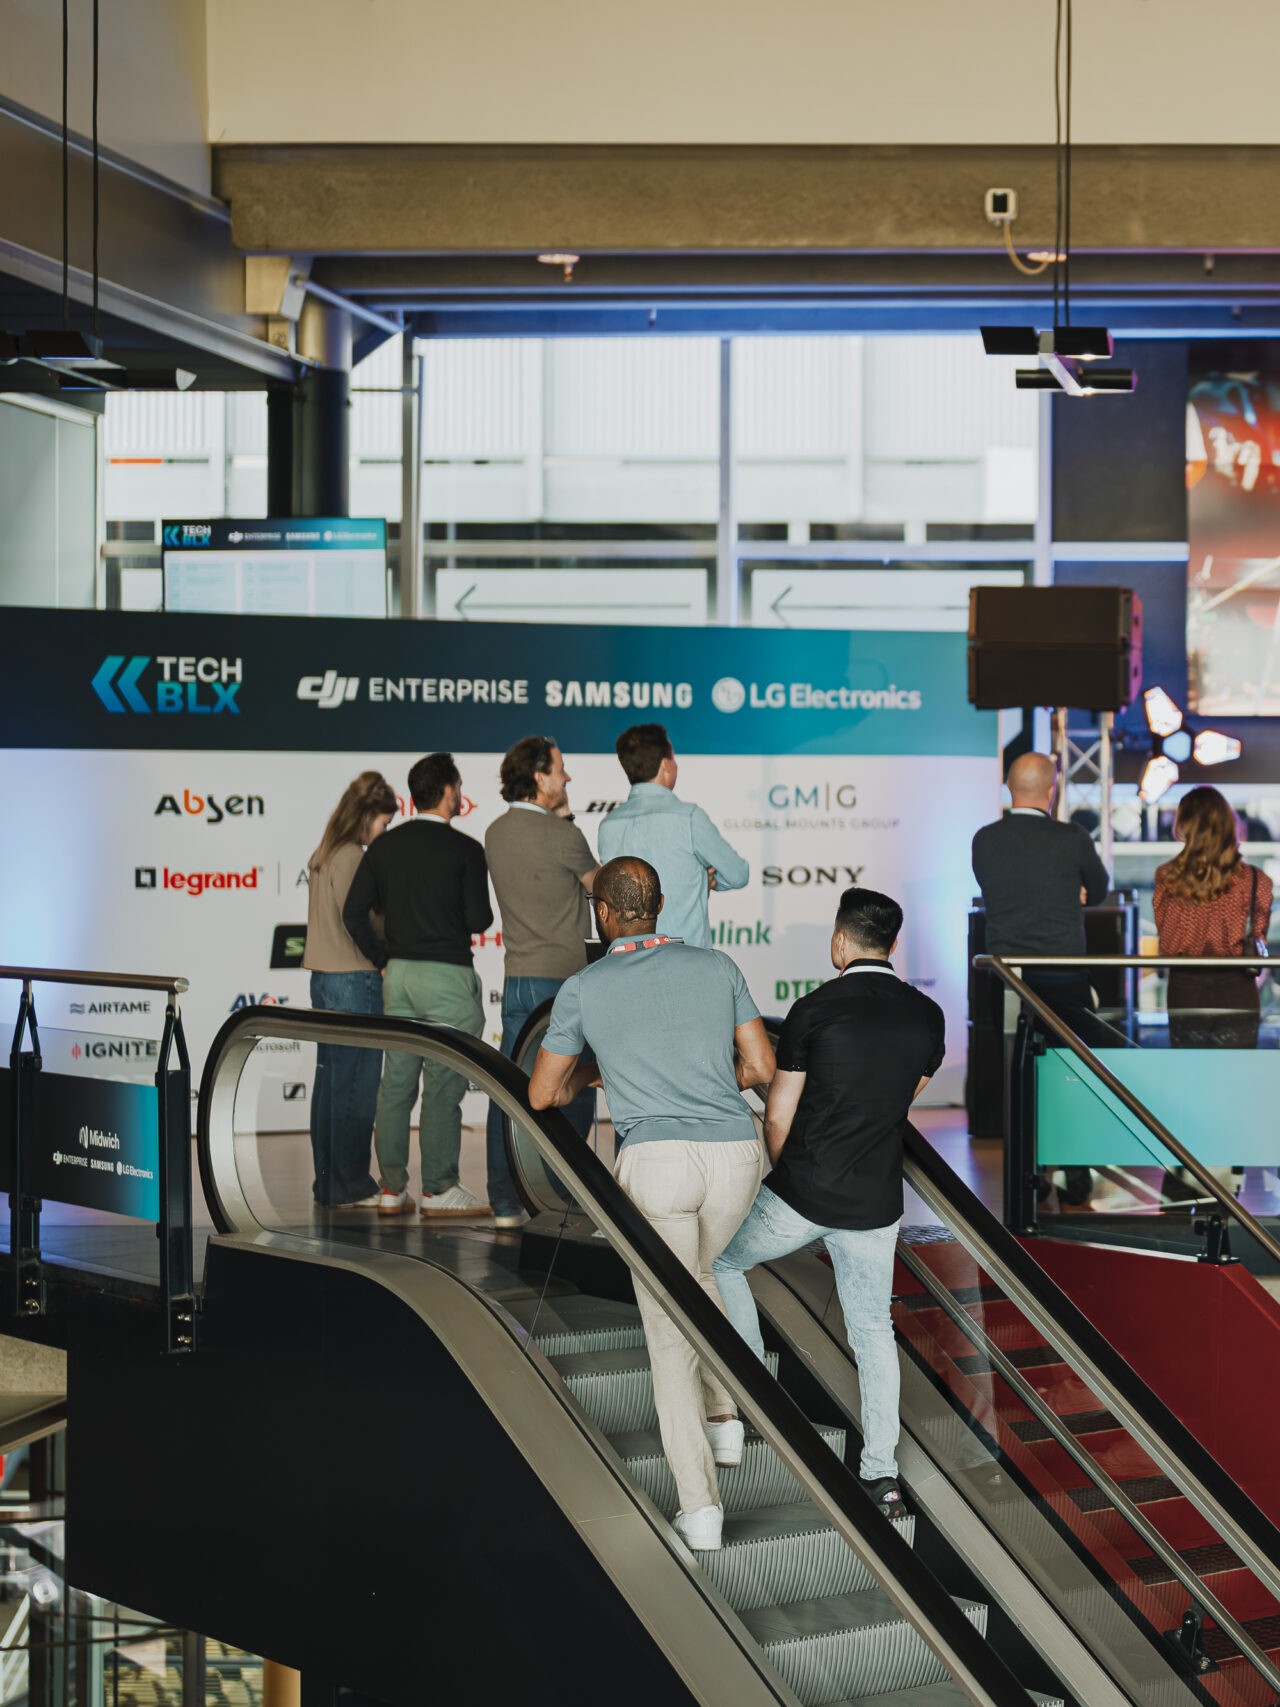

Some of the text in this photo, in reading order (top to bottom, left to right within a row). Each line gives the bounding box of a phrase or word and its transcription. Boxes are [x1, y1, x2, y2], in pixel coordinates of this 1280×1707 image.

[182, 525, 212, 536] TECH
[182, 535, 211, 547] BLX
[156, 656, 243, 682] TECH
[157, 681, 242, 714] BLX
[368, 677, 529, 704] ENTERPRISE
[545, 679, 693, 709] SAMSUNG
[750, 682, 786, 709] LG
[789, 683, 922, 710] Electronics
[154, 788, 264, 823] Absen
[724, 817, 900, 830] GLOBAL MOUNTS GROUP
[163, 867, 257, 896] legrand
[762, 865, 864, 887] SONY
[88, 1001, 152, 1014] AIRTAME
[85, 1041, 158, 1058] IGNITE
[89, 1129, 120, 1150] Midwich
[63, 1154, 88, 1168] ENTERPRISE
[90, 1158, 114, 1172] SAMSUNG
[122, 1164, 130, 1175] LG
[129, 1165, 154, 1179] Electronics
